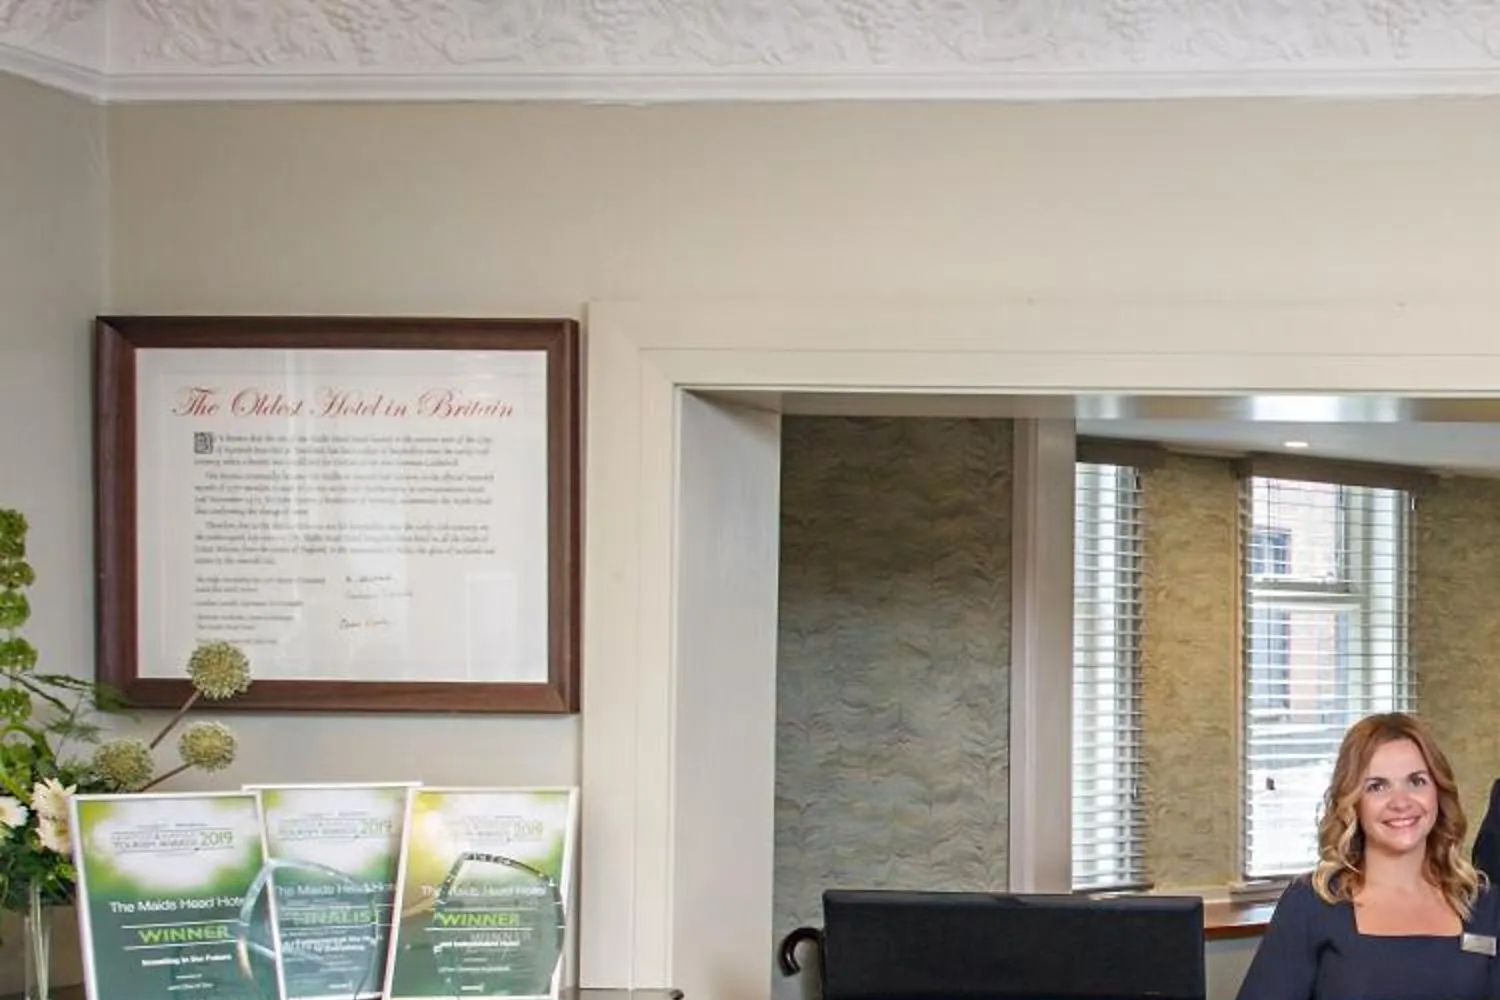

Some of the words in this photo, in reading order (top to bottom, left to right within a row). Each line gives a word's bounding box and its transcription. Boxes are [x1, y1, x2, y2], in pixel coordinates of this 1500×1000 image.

[172, 387, 219, 417] The
[231, 388, 303, 418] Oldest
[309, 388, 384, 418] Hotel
[384, 400, 407, 417] in
[417, 388, 514, 418] Britain
[200, 831, 234, 846] 2019
[109, 902, 135, 913] The
[137, 900, 177, 912] Maids
[180, 898, 214, 910] Head
[217, 896, 246, 908] Hote
[440, 912, 521, 926] WINNER
[138, 925, 231, 944] WINNER
